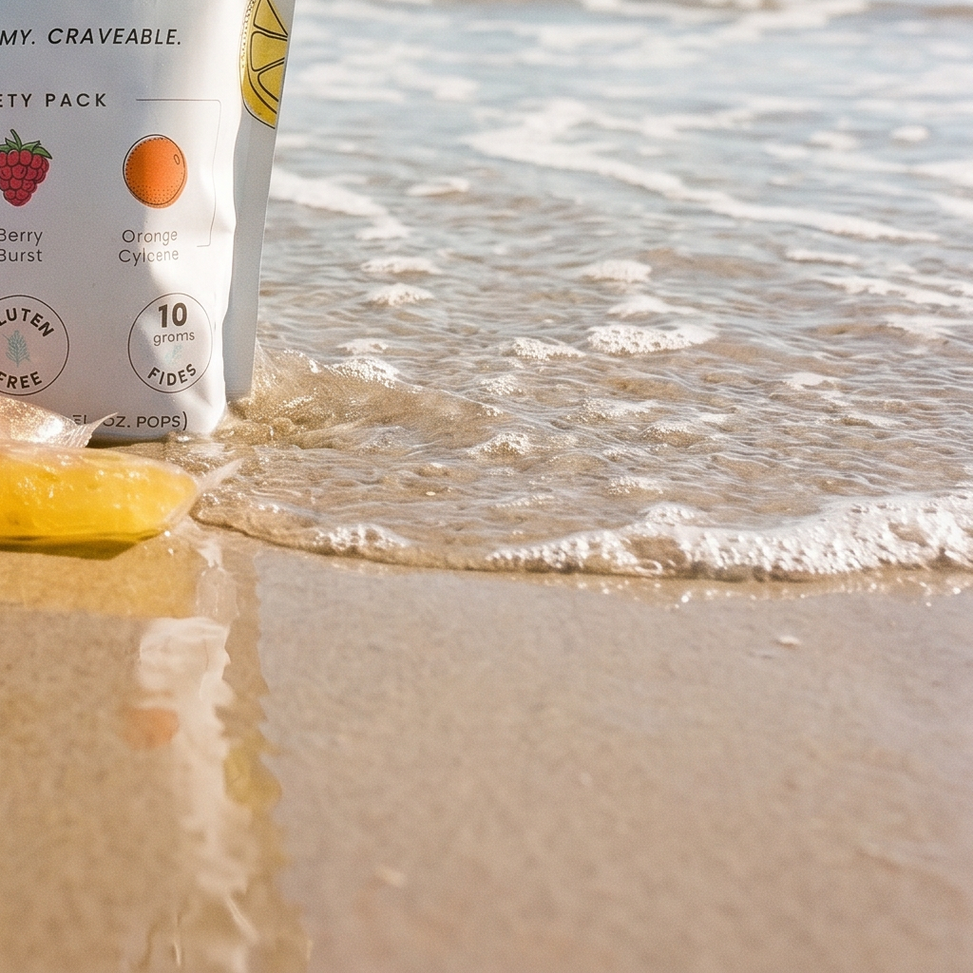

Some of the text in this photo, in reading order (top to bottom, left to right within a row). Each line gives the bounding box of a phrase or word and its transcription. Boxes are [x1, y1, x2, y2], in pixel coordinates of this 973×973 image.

[47, 27, 181, 46] CRAVEABLE.
[45, 92, 107, 108] PACK
[158, 302, 188, 328] 10
[147, 363, 197, 386] FIDES
[136, 410, 188, 431] POPS)
